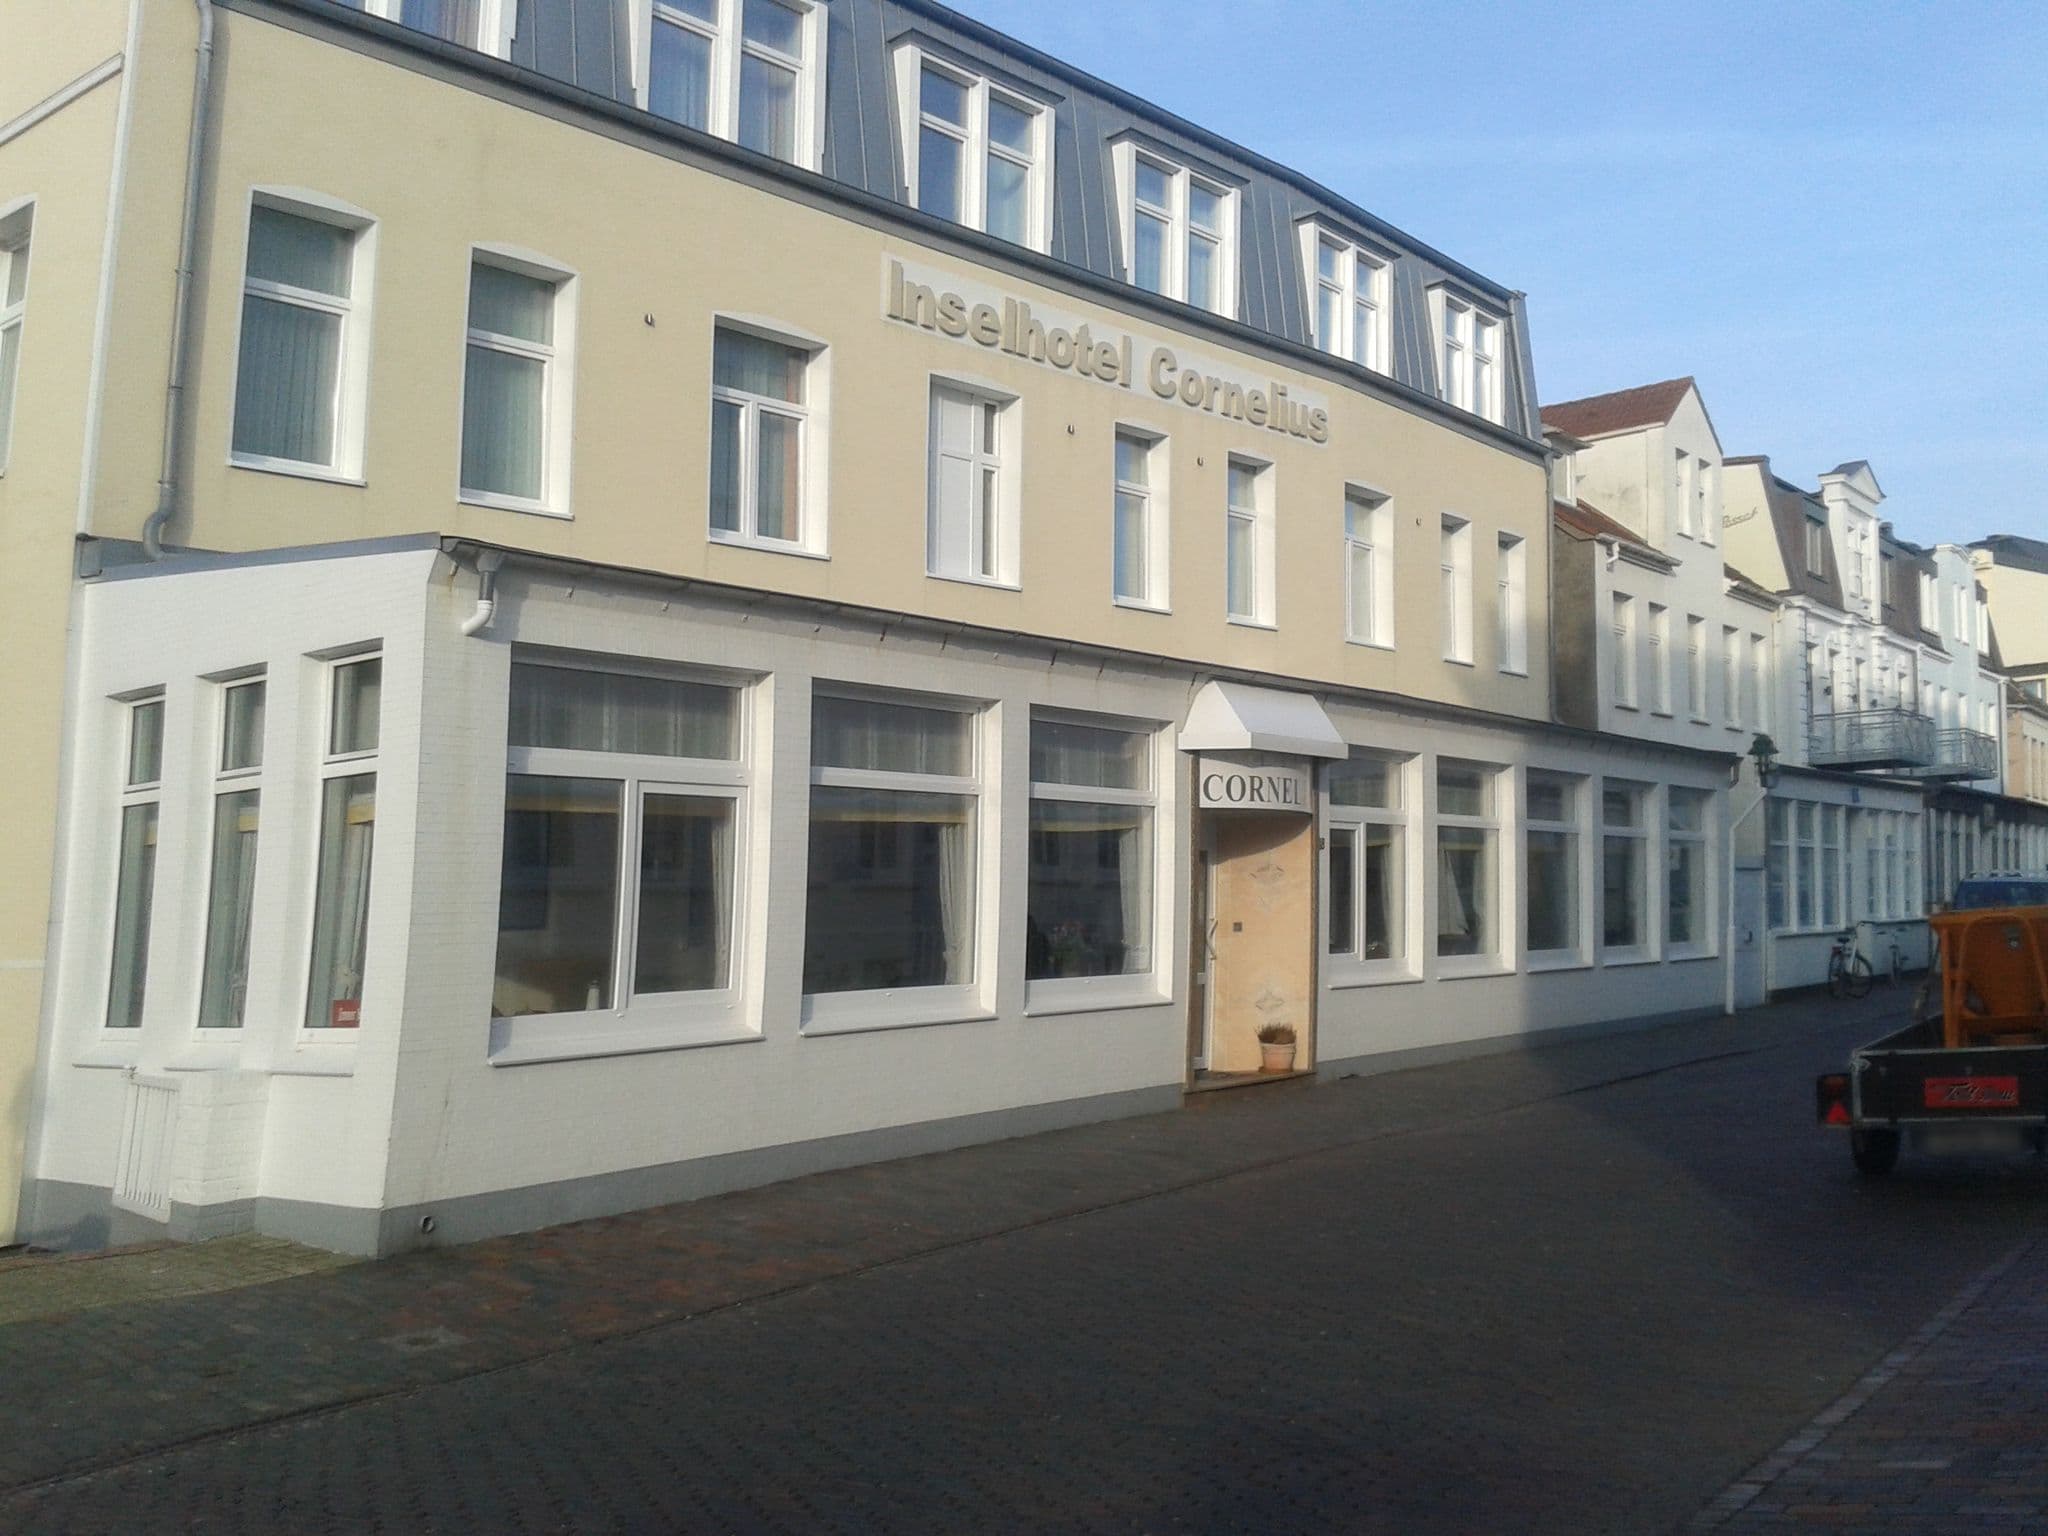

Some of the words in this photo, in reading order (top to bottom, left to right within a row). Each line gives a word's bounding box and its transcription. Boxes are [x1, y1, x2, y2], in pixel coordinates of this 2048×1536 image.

[886, 259, 1132, 388] Inselhotel
[1149, 347, 1328, 442] Cornelius
[1203, 774, 1301, 804] CORNEL
